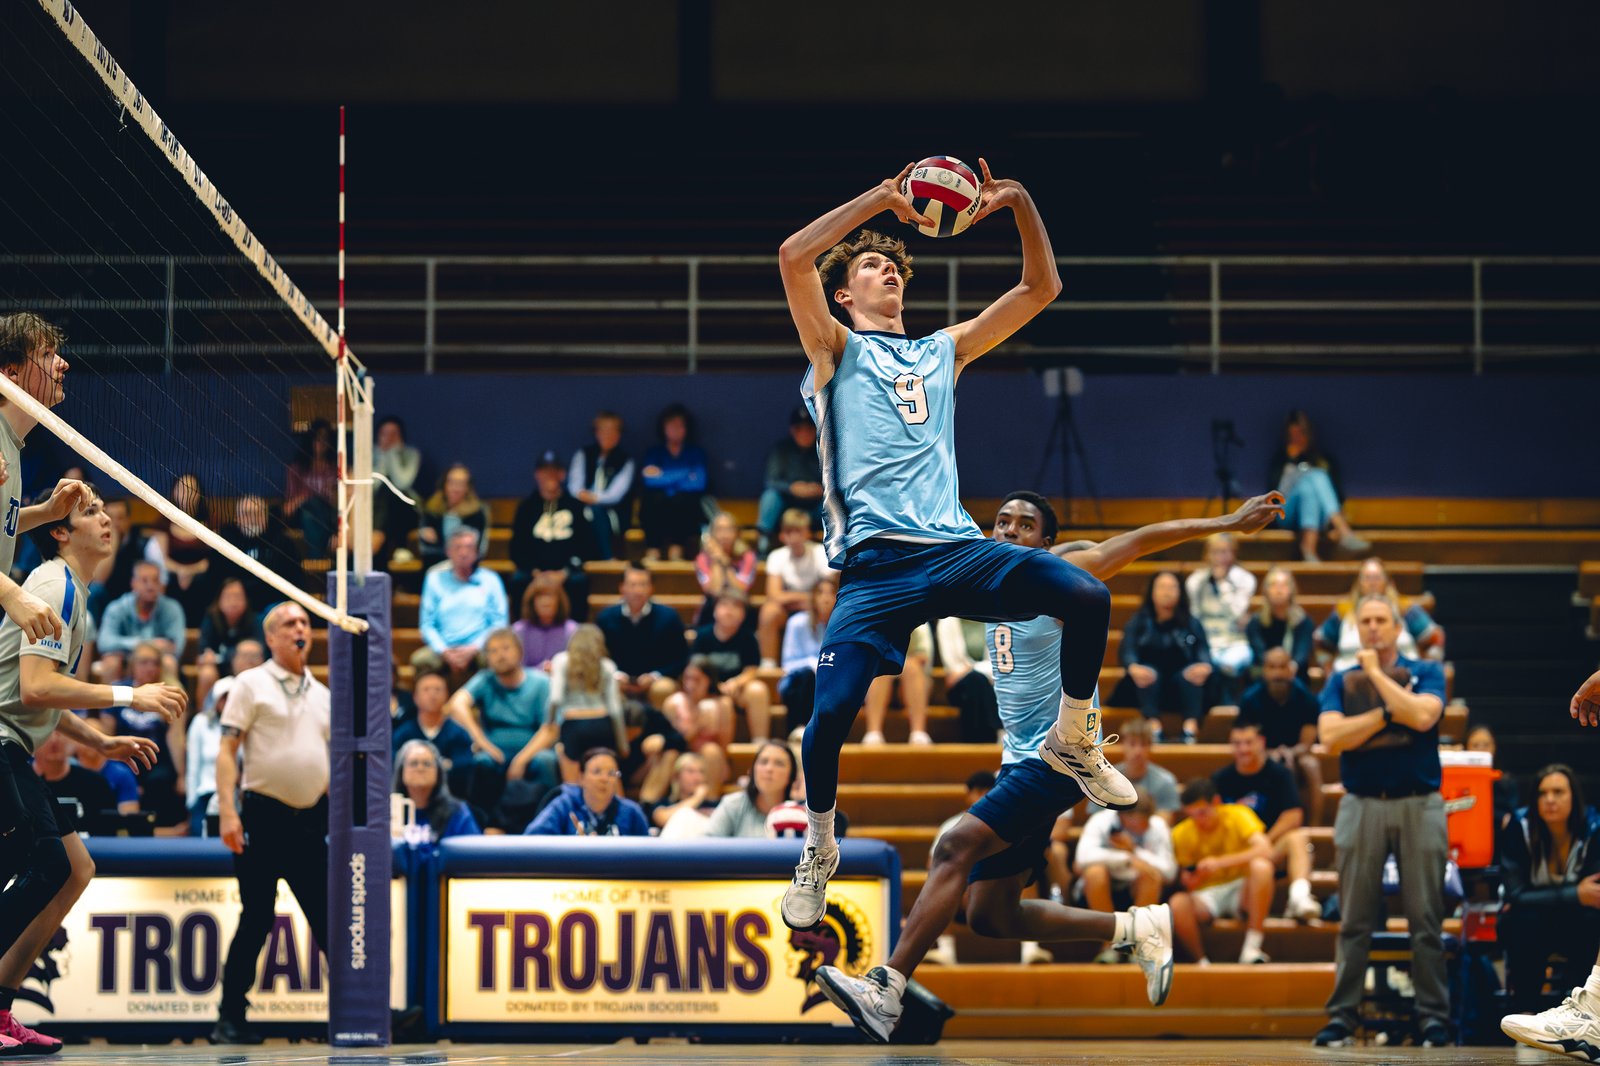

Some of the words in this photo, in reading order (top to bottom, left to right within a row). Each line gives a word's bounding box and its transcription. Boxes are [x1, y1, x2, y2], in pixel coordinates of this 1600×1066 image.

[893, 372, 930, 425] 9
[533, 509, 574, 543] 42
[994, 623, 1015, 674] 8
[174, 889, 224, 903] HOME
[349, 852, 367, 905] sports
[553, 889, 604, 903] HOME
[609, 889, 632, 903] OF
[638, 889, 671, 904] THE
[349, 906, 367, 970] imports
[467, 908, 772, 996] TROJANS
[127, 1001, 190, 1014] DONATED
[506, 1001, 568, 1013] DONATED
[571, 1001, 589, 1013] BY
[593, 1001, 644, 1013] TROJAN
[647, 1001, 719, 1013] BOOSTERS
